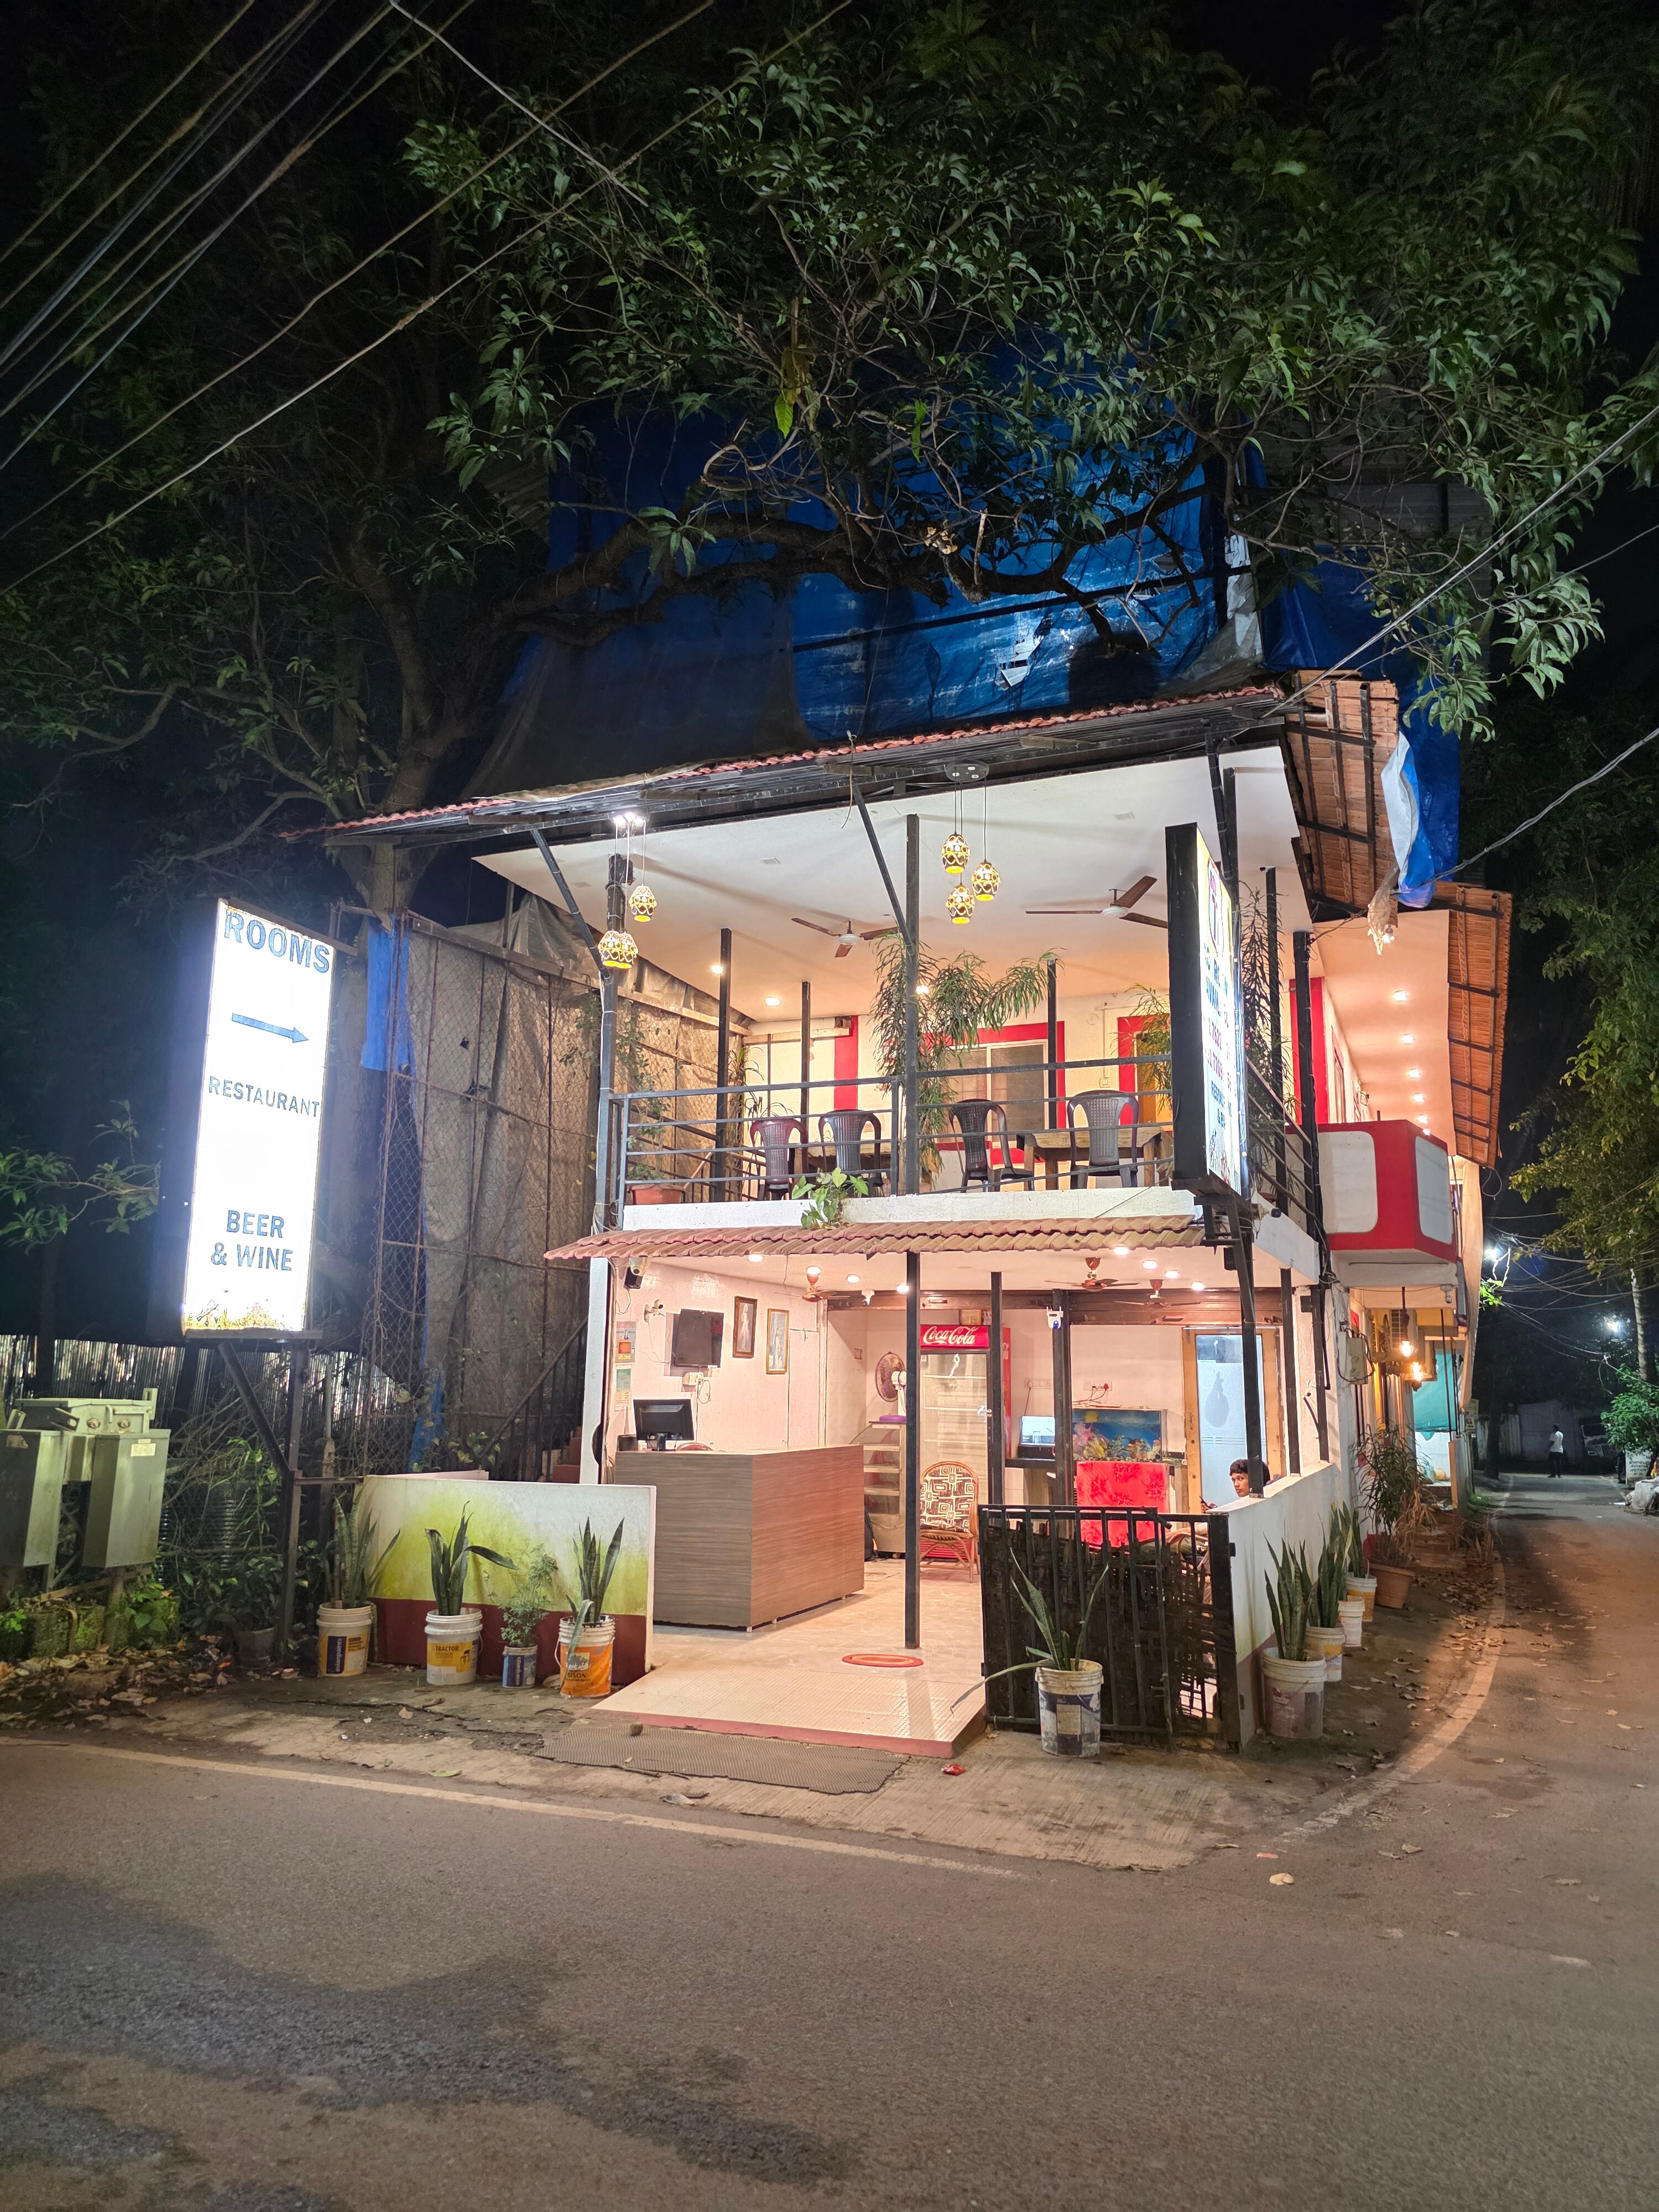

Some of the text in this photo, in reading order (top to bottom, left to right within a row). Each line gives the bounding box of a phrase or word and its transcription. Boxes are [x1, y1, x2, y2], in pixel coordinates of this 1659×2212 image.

[224, 909, 331, 974] ROOMS
[208, 1076, 321, 1118] RESTAURANT
[227, 1209, 284, 1239] BEER
[211, 1242, 294, 1271] & WINE
[923, 1326, 979, 1345] Coca-Cola
